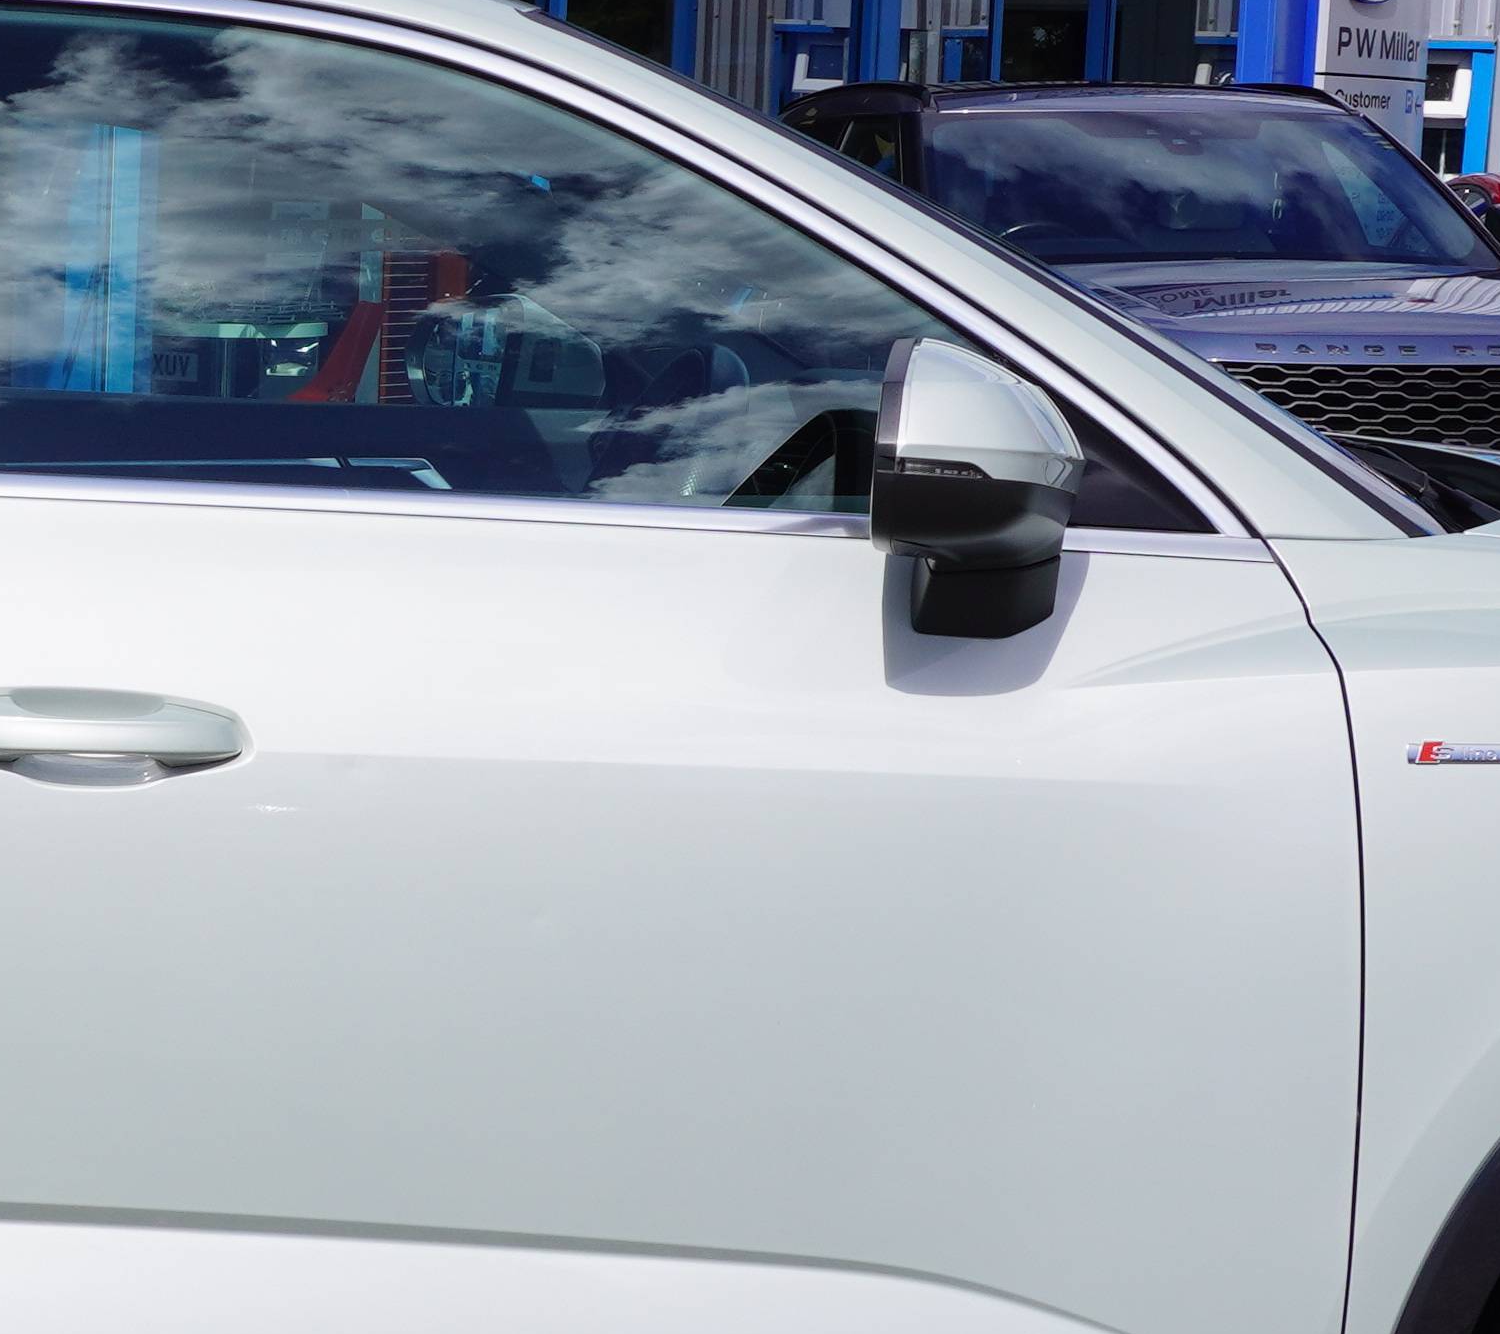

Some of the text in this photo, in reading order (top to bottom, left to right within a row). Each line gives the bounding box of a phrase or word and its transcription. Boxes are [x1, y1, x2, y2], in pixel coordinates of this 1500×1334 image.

[1337, 26, 1420, 63] P W Millar
[1255, 342, 1418, 355] RANGE
